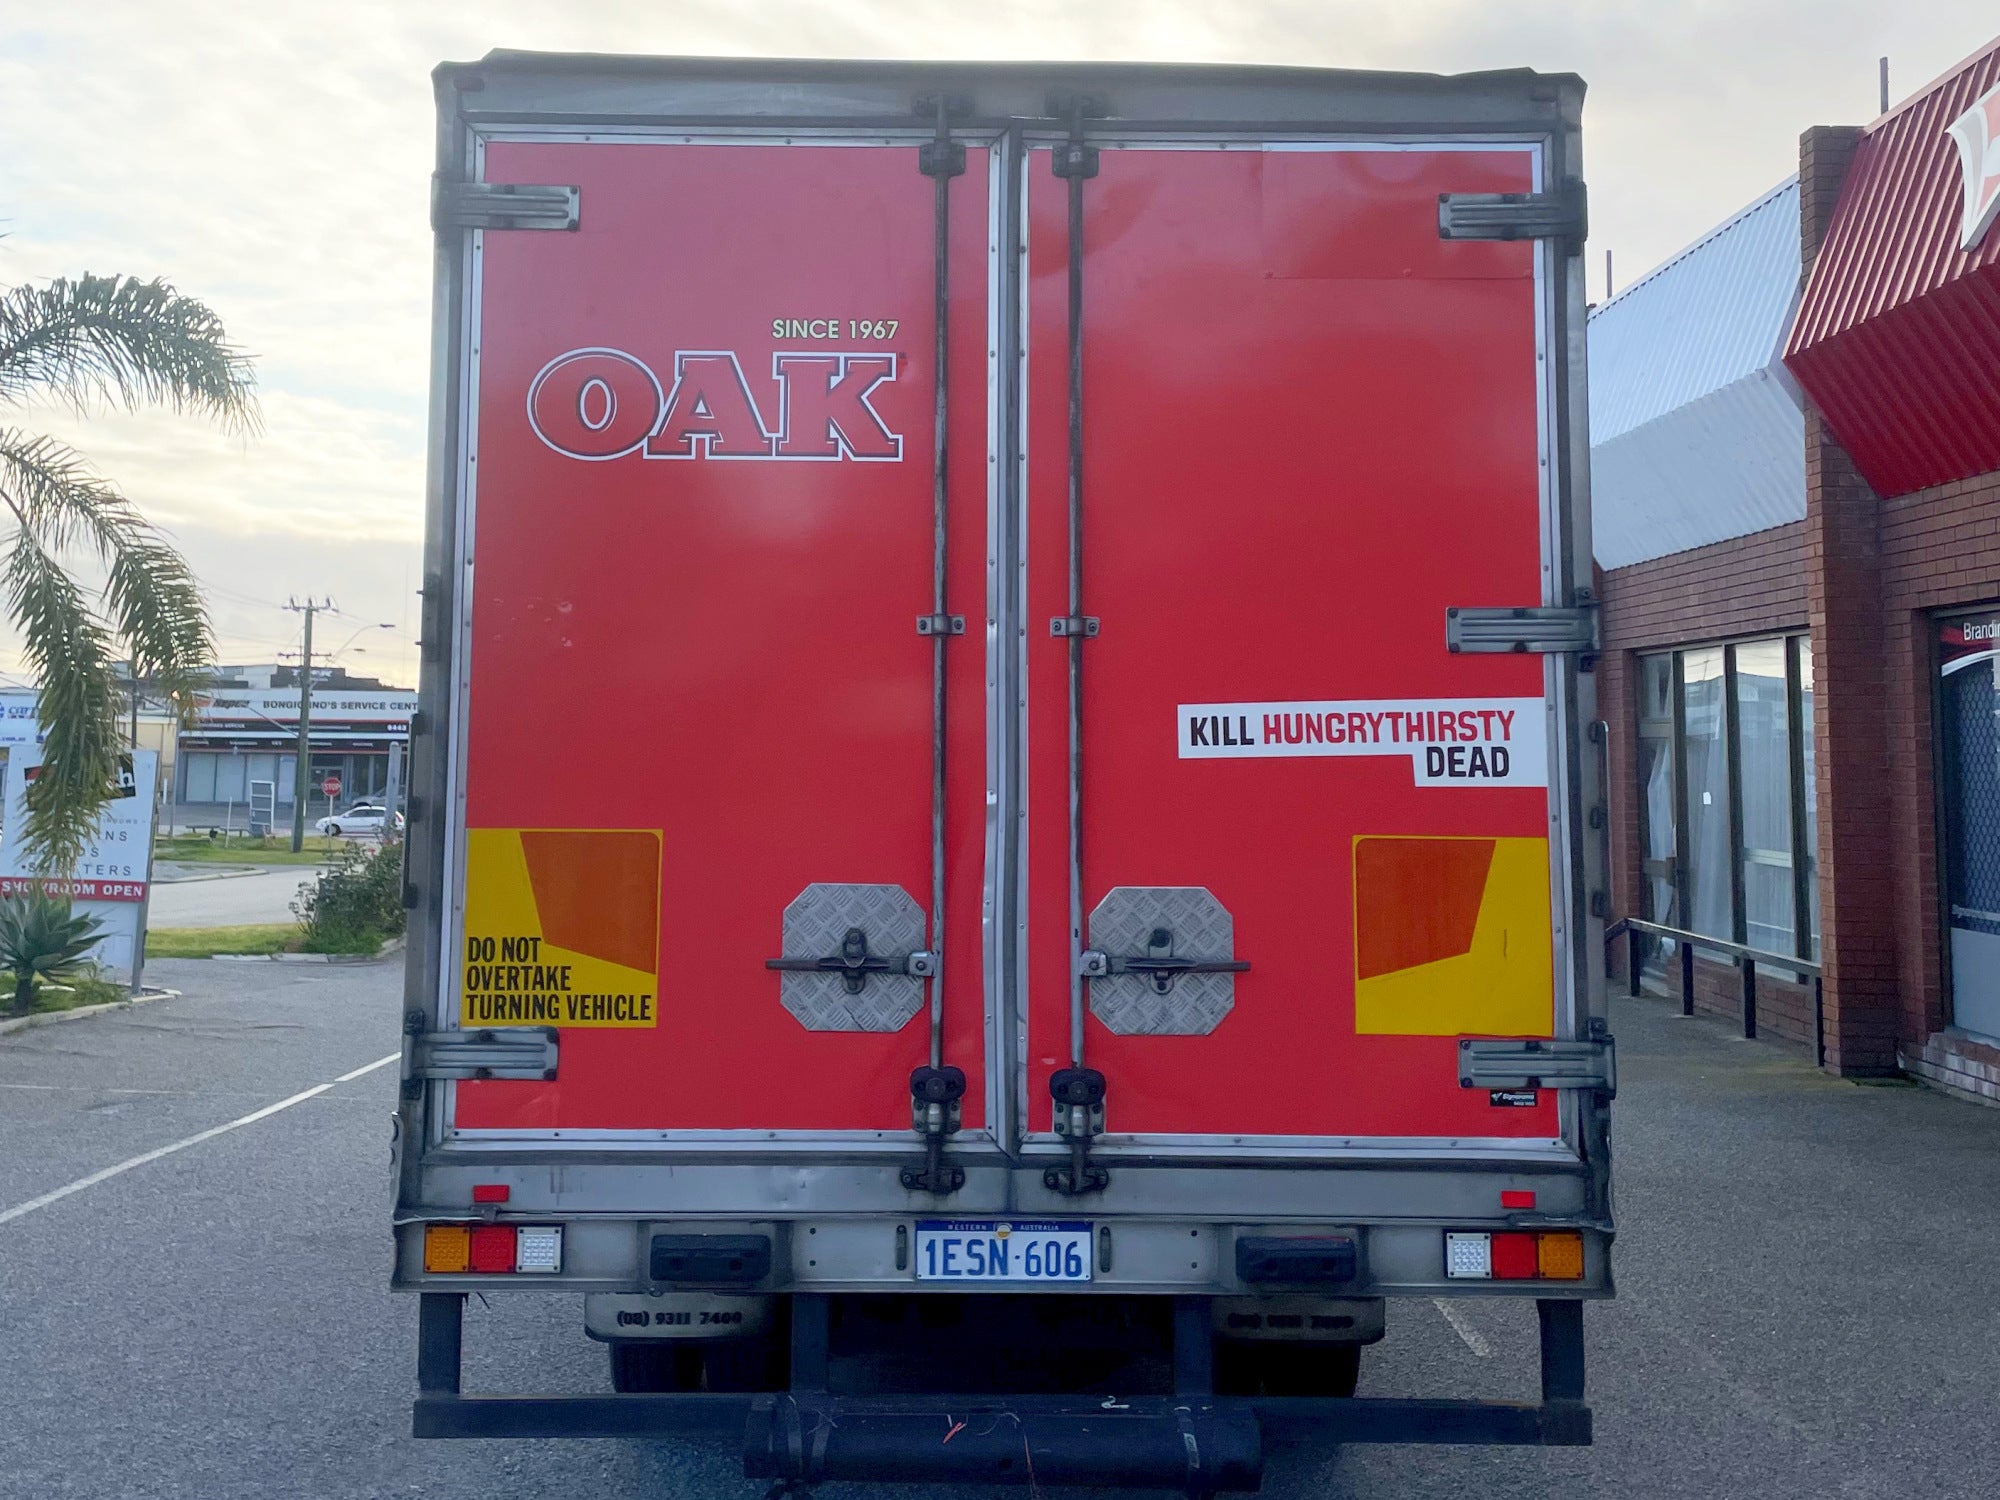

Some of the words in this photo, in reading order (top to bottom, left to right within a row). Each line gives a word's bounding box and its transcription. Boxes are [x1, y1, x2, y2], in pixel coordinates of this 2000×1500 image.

[772, 319, 840, 339] SINCE
[849, 320, 899, 340] 1967
[527, 347, 903, 462] OAK
[340, 701, 386, 710] SERVICE
[1190, 716, 1255, 746] KILL
[1427, 746, 1510, 778] DEAD
[102, 884, 143, 896] OPEN
[467, 937, 496, 962] DO
[501, 937, 542, 962] NOT
[466, 966, 572, 991] OVERTAKE
[466, 994, 560, 1020] TURNING
[567, 995, 652, 1021] VEHICLE
[1020, 1224, 1059, 1232] AUSTRALIA
